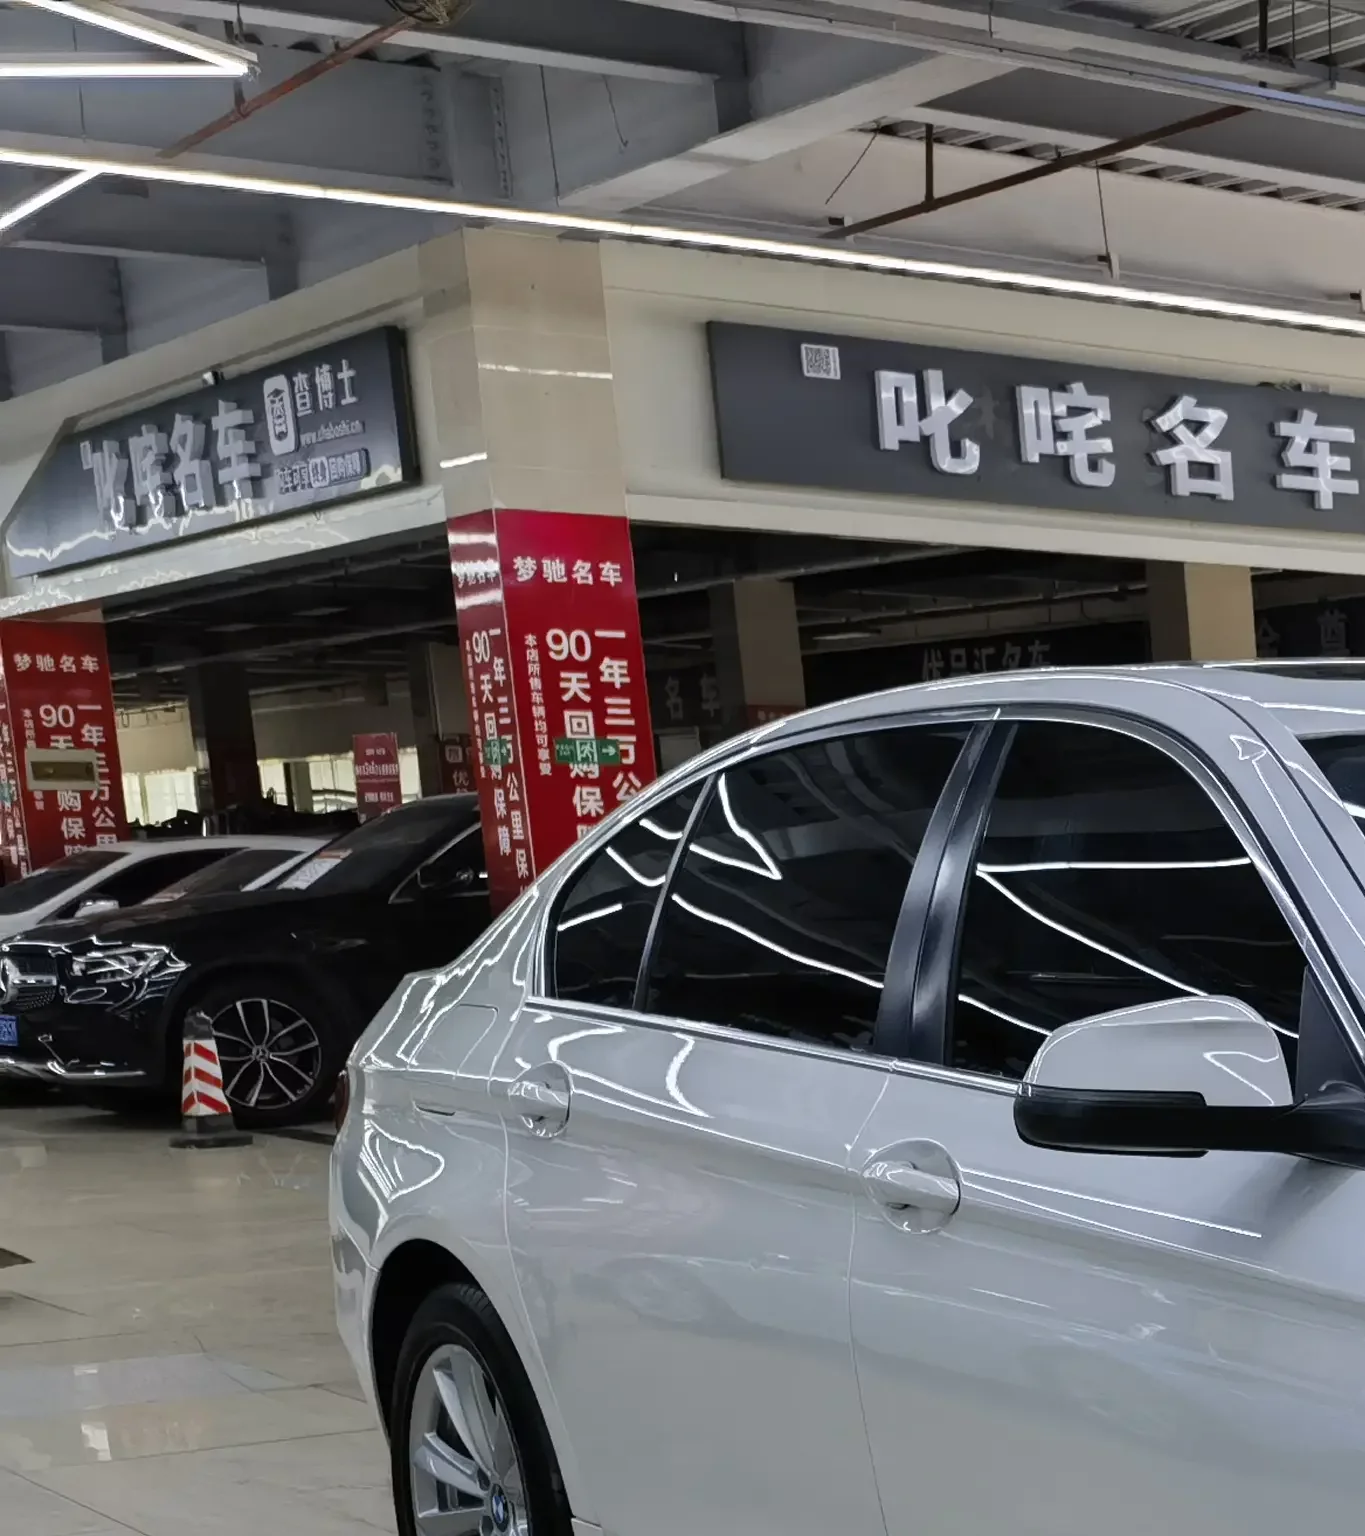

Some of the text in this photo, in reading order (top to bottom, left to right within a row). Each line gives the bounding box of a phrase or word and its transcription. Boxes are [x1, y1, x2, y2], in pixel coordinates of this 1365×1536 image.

[292, 359, 357, 417] 查博士
[873, 367, 1361, 512] 叱咤名车
[513, 556, 623, 587] 梦驰名车
[13, 652, 100, 673] 梦驰名车
